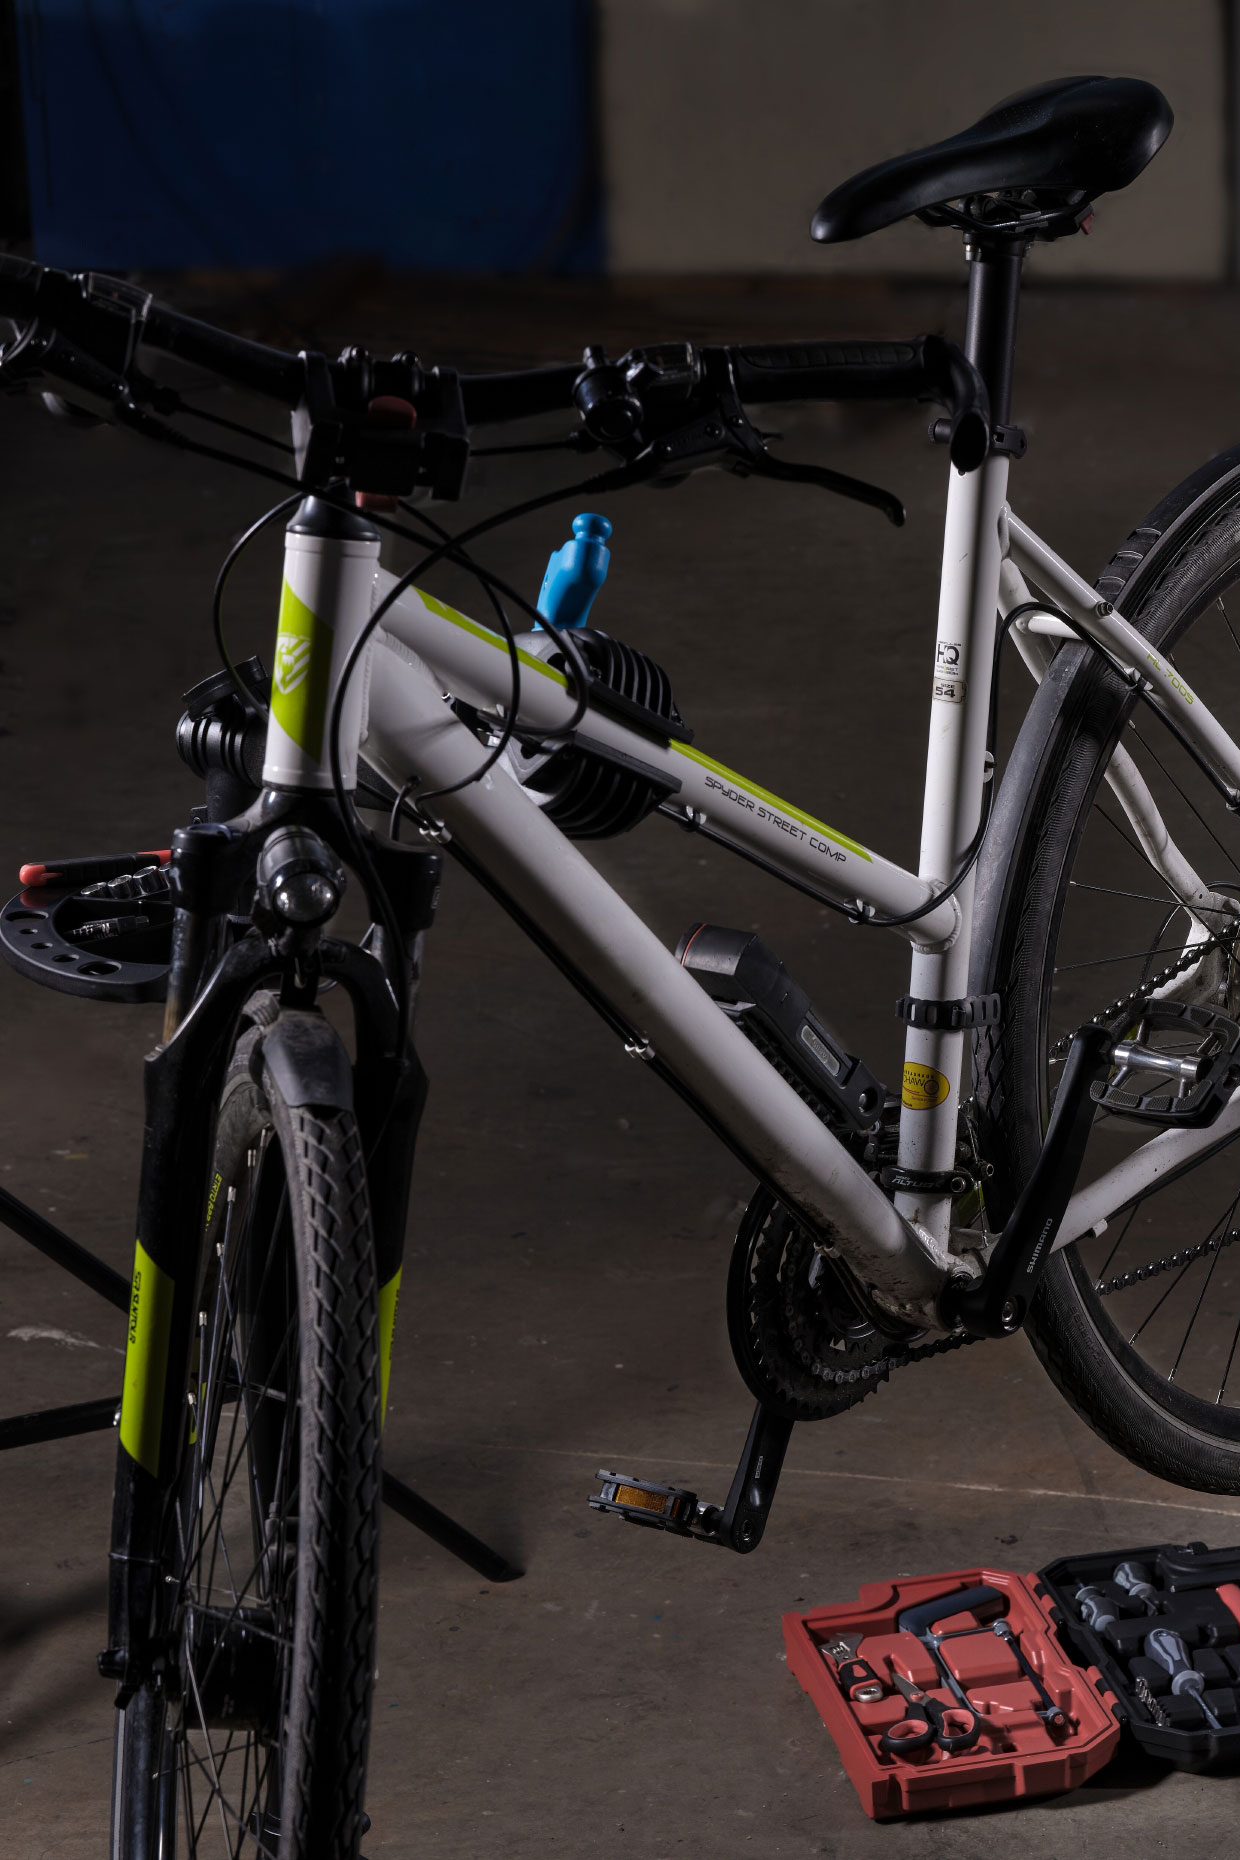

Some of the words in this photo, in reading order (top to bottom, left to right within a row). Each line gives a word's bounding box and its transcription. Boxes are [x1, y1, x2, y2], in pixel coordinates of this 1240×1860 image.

[935, 686, 956, 698] 54
[704, 776, 755, 812] SPYDER
[757, 806, 807, 841] STREET
[809, 837, 847, 863] COMP
[1026, 1217, 1053, 1274] SHIMANO
